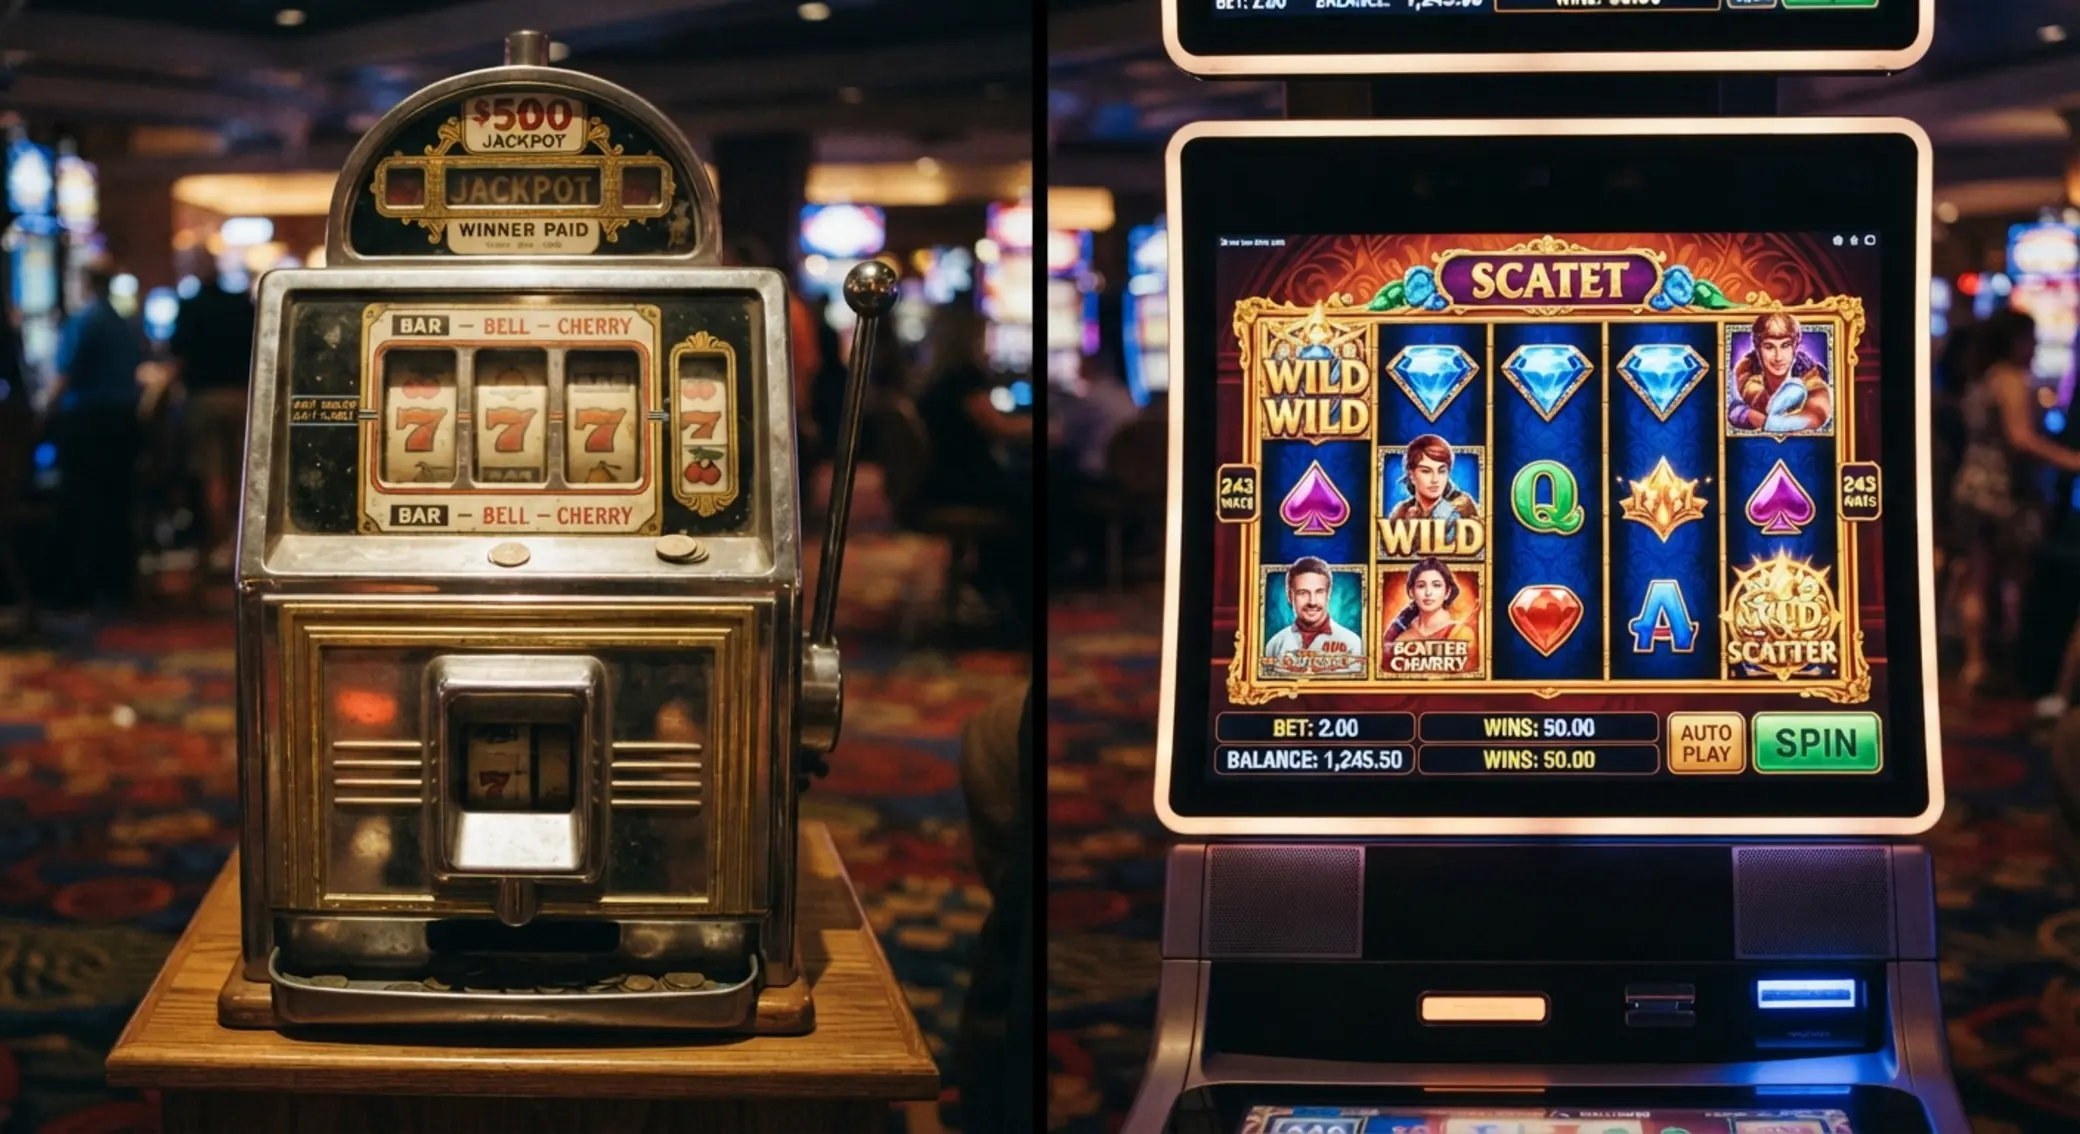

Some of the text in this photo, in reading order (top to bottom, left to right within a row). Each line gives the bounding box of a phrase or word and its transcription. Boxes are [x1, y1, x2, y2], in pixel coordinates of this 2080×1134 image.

[471, 98, 573, 131] $500
[451, 175, 592, 203] JACKPOT
[460, 222, 589, 237] WINNER PAID
[1471, 261, 1630, 299] SCATET
[400, 317, 633, 335] BAR BELL CHERRY
[1264, 357, 1370, 395] WILD
[396, 406, 448, 452] 7
[485, 406, 538, 452] 7
[574, 406, 627, 452] 7
[680, 410, 721, 439] 7
[1264, 396, 1370, 435] WILD
[1511, 459, 1585, 535] Q
[398, 506, 633, 525] BAR BELL CHERRY
[1377, 517, 1485, 556] WILD
[1628, 579, 1699, 653] A
[1728, 641, 1838, 664] SCATTER
[1273, 718, 1359, 737] BET: 2.00
[1484, 718, 1595, 737] WINS: 50.00
[1681, 724, 1733, 742] AUTO
[1683, 746, 1732, 762] PLAY
[1775, 728, 1857, 758] SPIN
[1227, 750, 1403, 772] BALANCE: 1,245.50
[1483, 750, 1595, 769] WINS: 50.00
